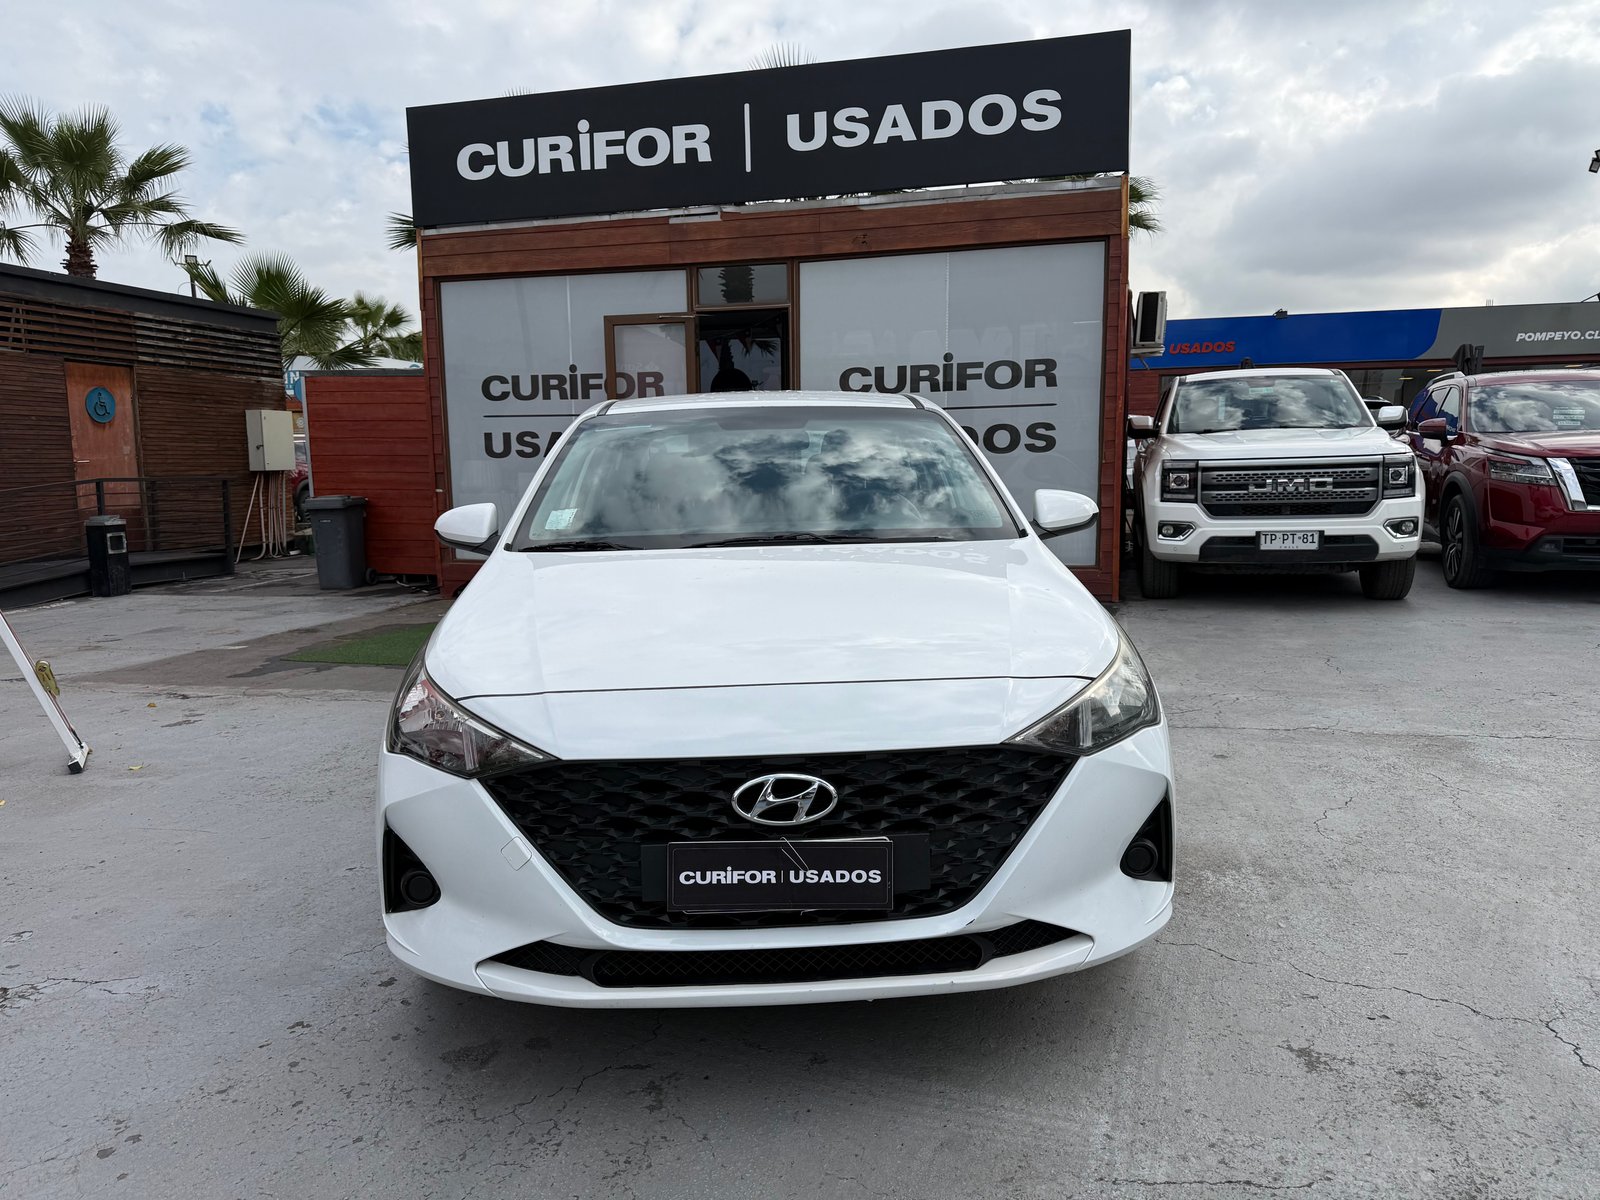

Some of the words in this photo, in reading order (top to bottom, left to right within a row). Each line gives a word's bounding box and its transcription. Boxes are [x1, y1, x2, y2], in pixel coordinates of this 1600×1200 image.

[786, 89, 1062, 152] USADOS
[1169, 341, 1236, 355] USADOS
[789, 869, 882, 884] USADOS
